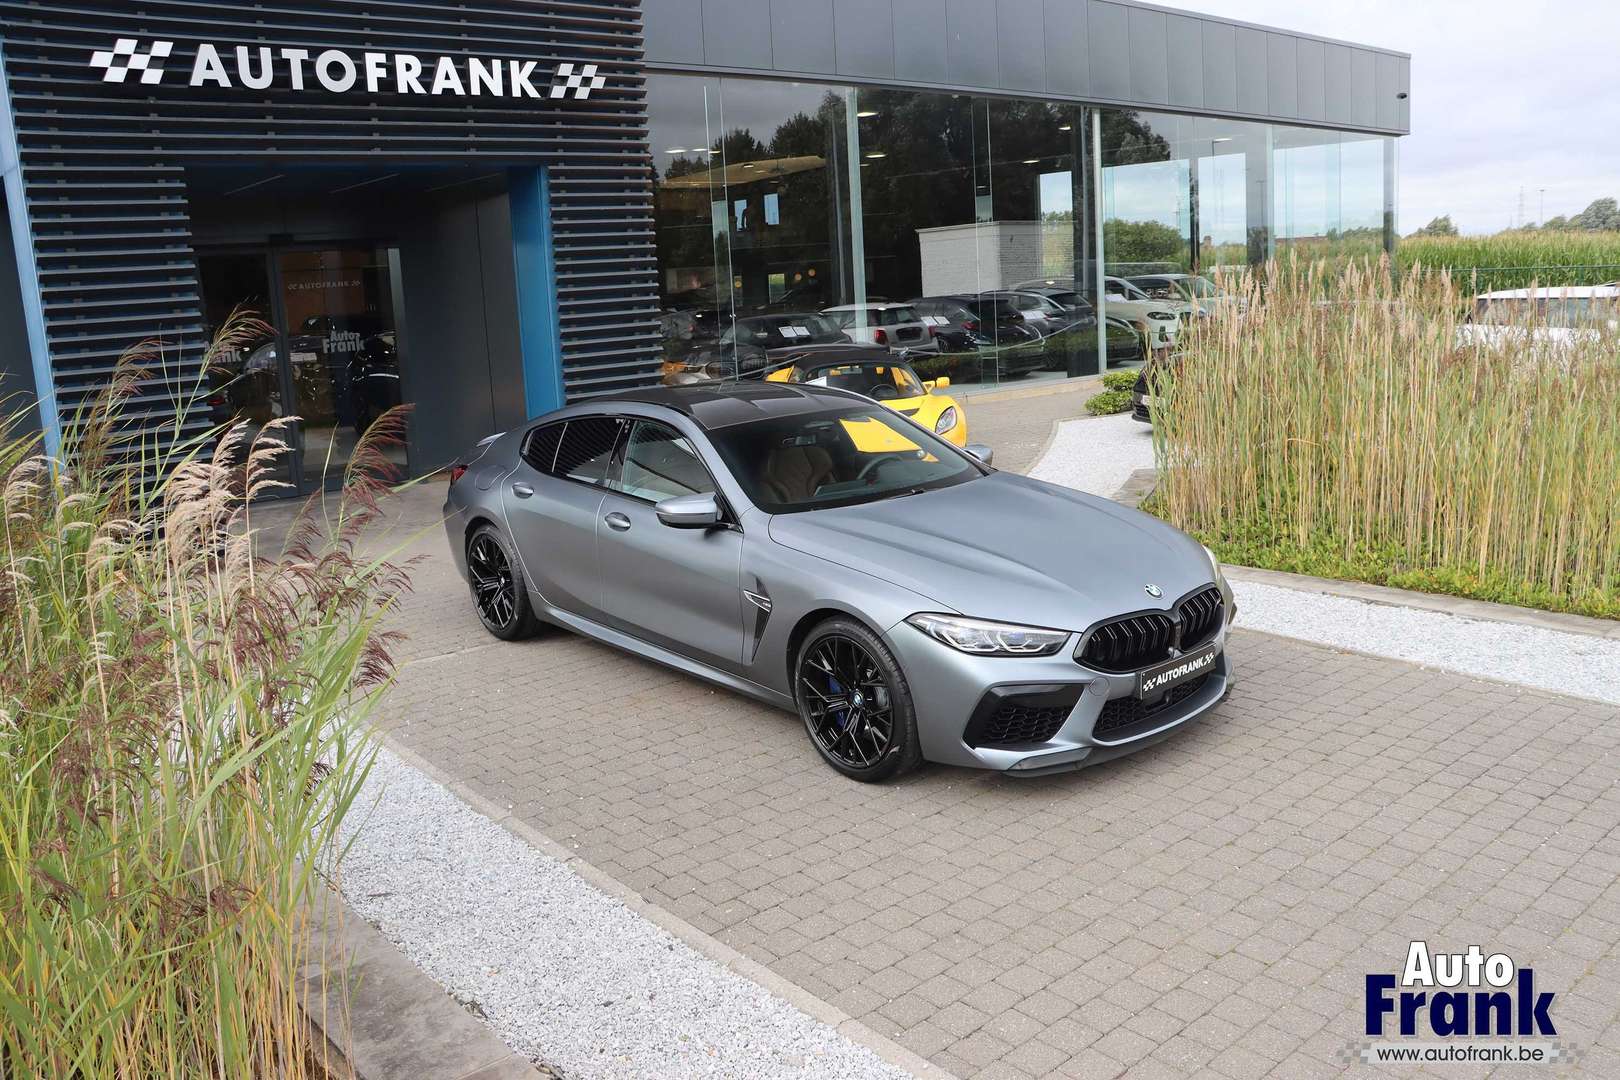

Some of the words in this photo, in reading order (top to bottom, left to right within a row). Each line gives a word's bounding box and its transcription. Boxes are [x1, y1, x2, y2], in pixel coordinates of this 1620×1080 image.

[189, 43, 542, 98] AUTOFRANK
[322, 335, 365, 353] Frank
[330, 330, 356, 342] Auto
[1156, 656, 1204, 686] AUTOFRANK
